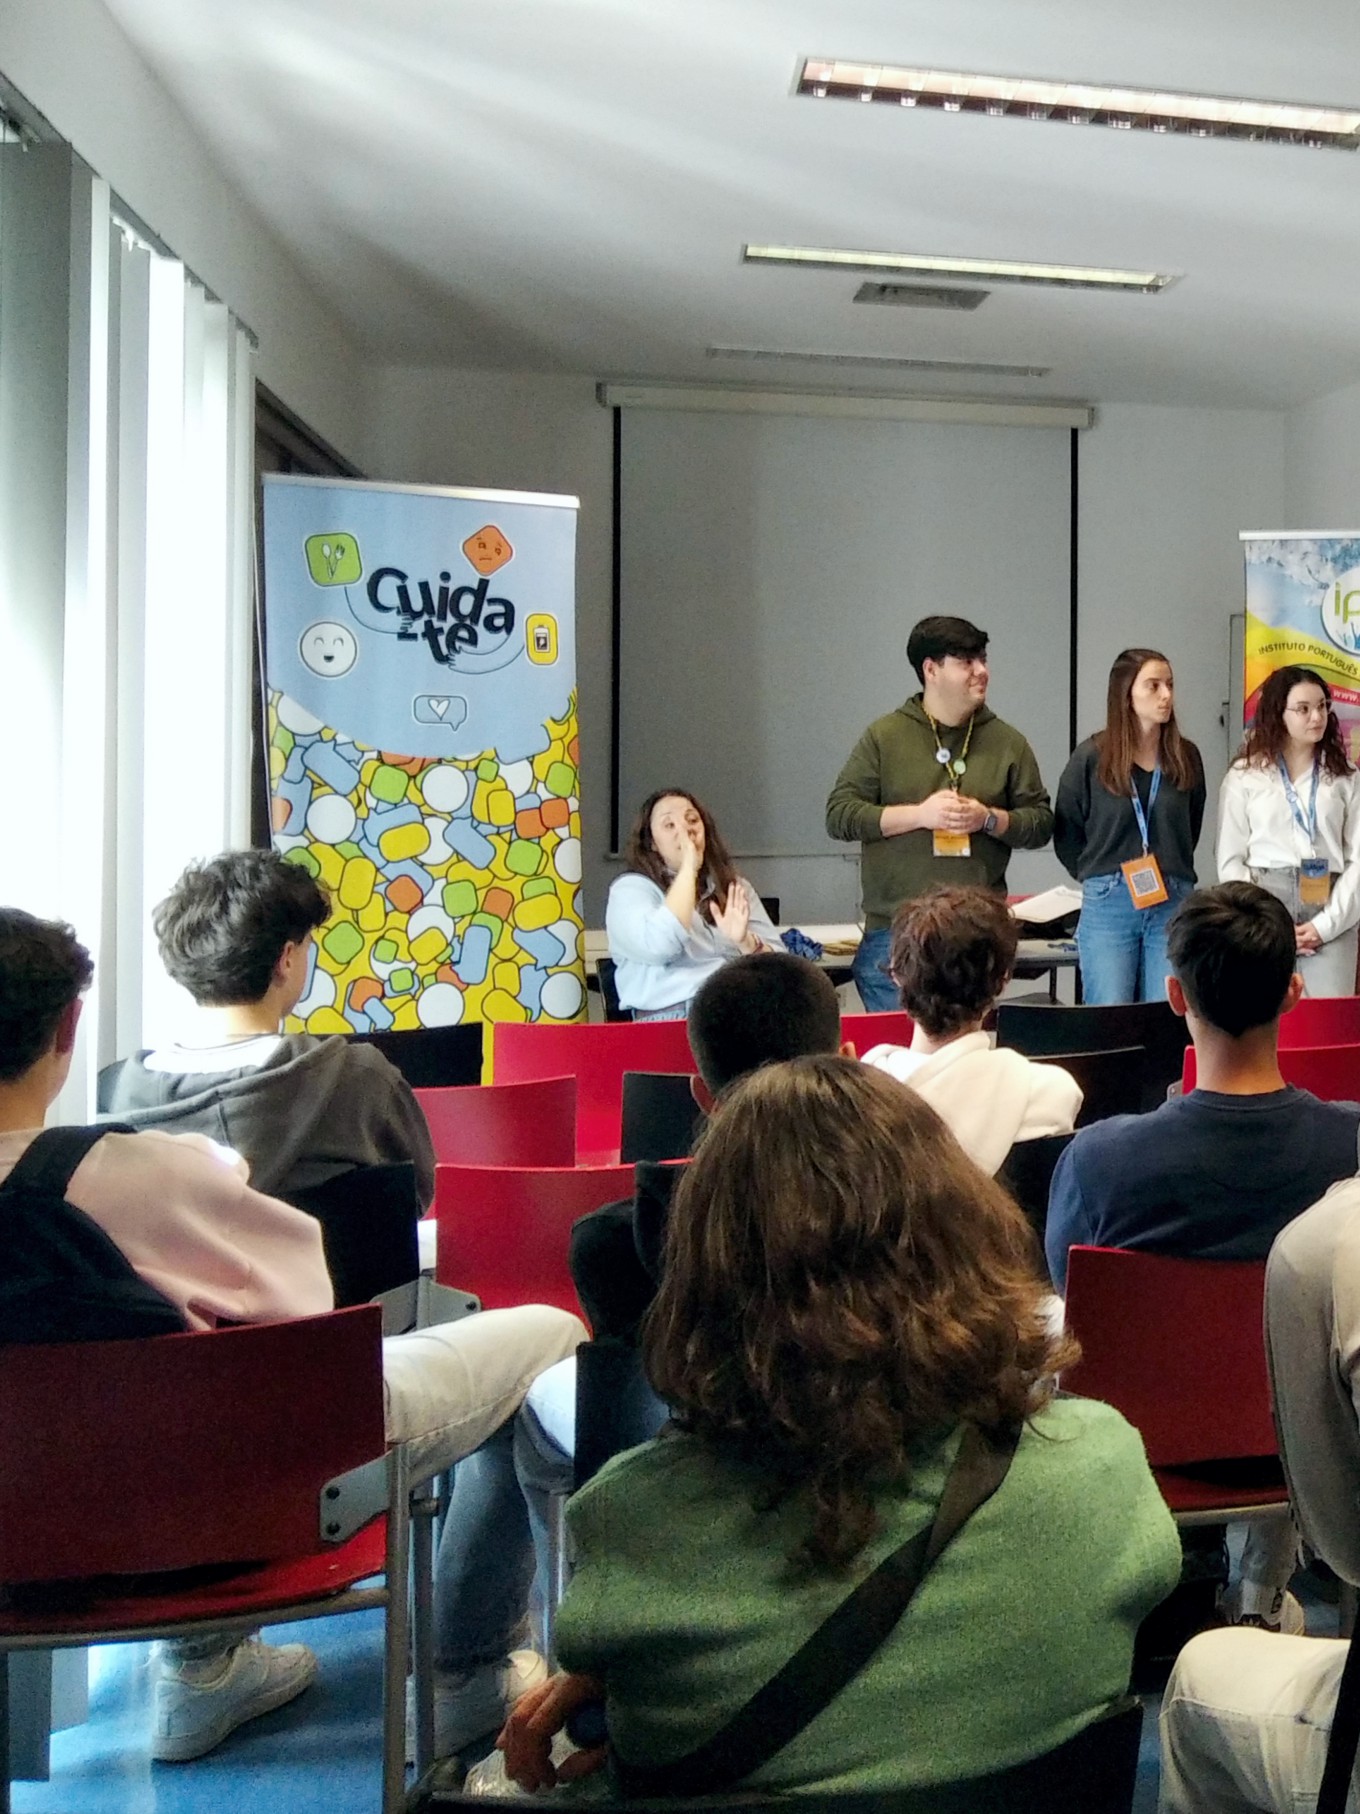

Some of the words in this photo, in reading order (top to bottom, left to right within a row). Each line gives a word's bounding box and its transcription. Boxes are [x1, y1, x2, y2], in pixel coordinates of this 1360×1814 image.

[366, 567, 516, 634] Cuida
[1258, 642, 1306, 655] INSTITUTO
[1307, 644, 1358, 676] PORTUGUÊS
